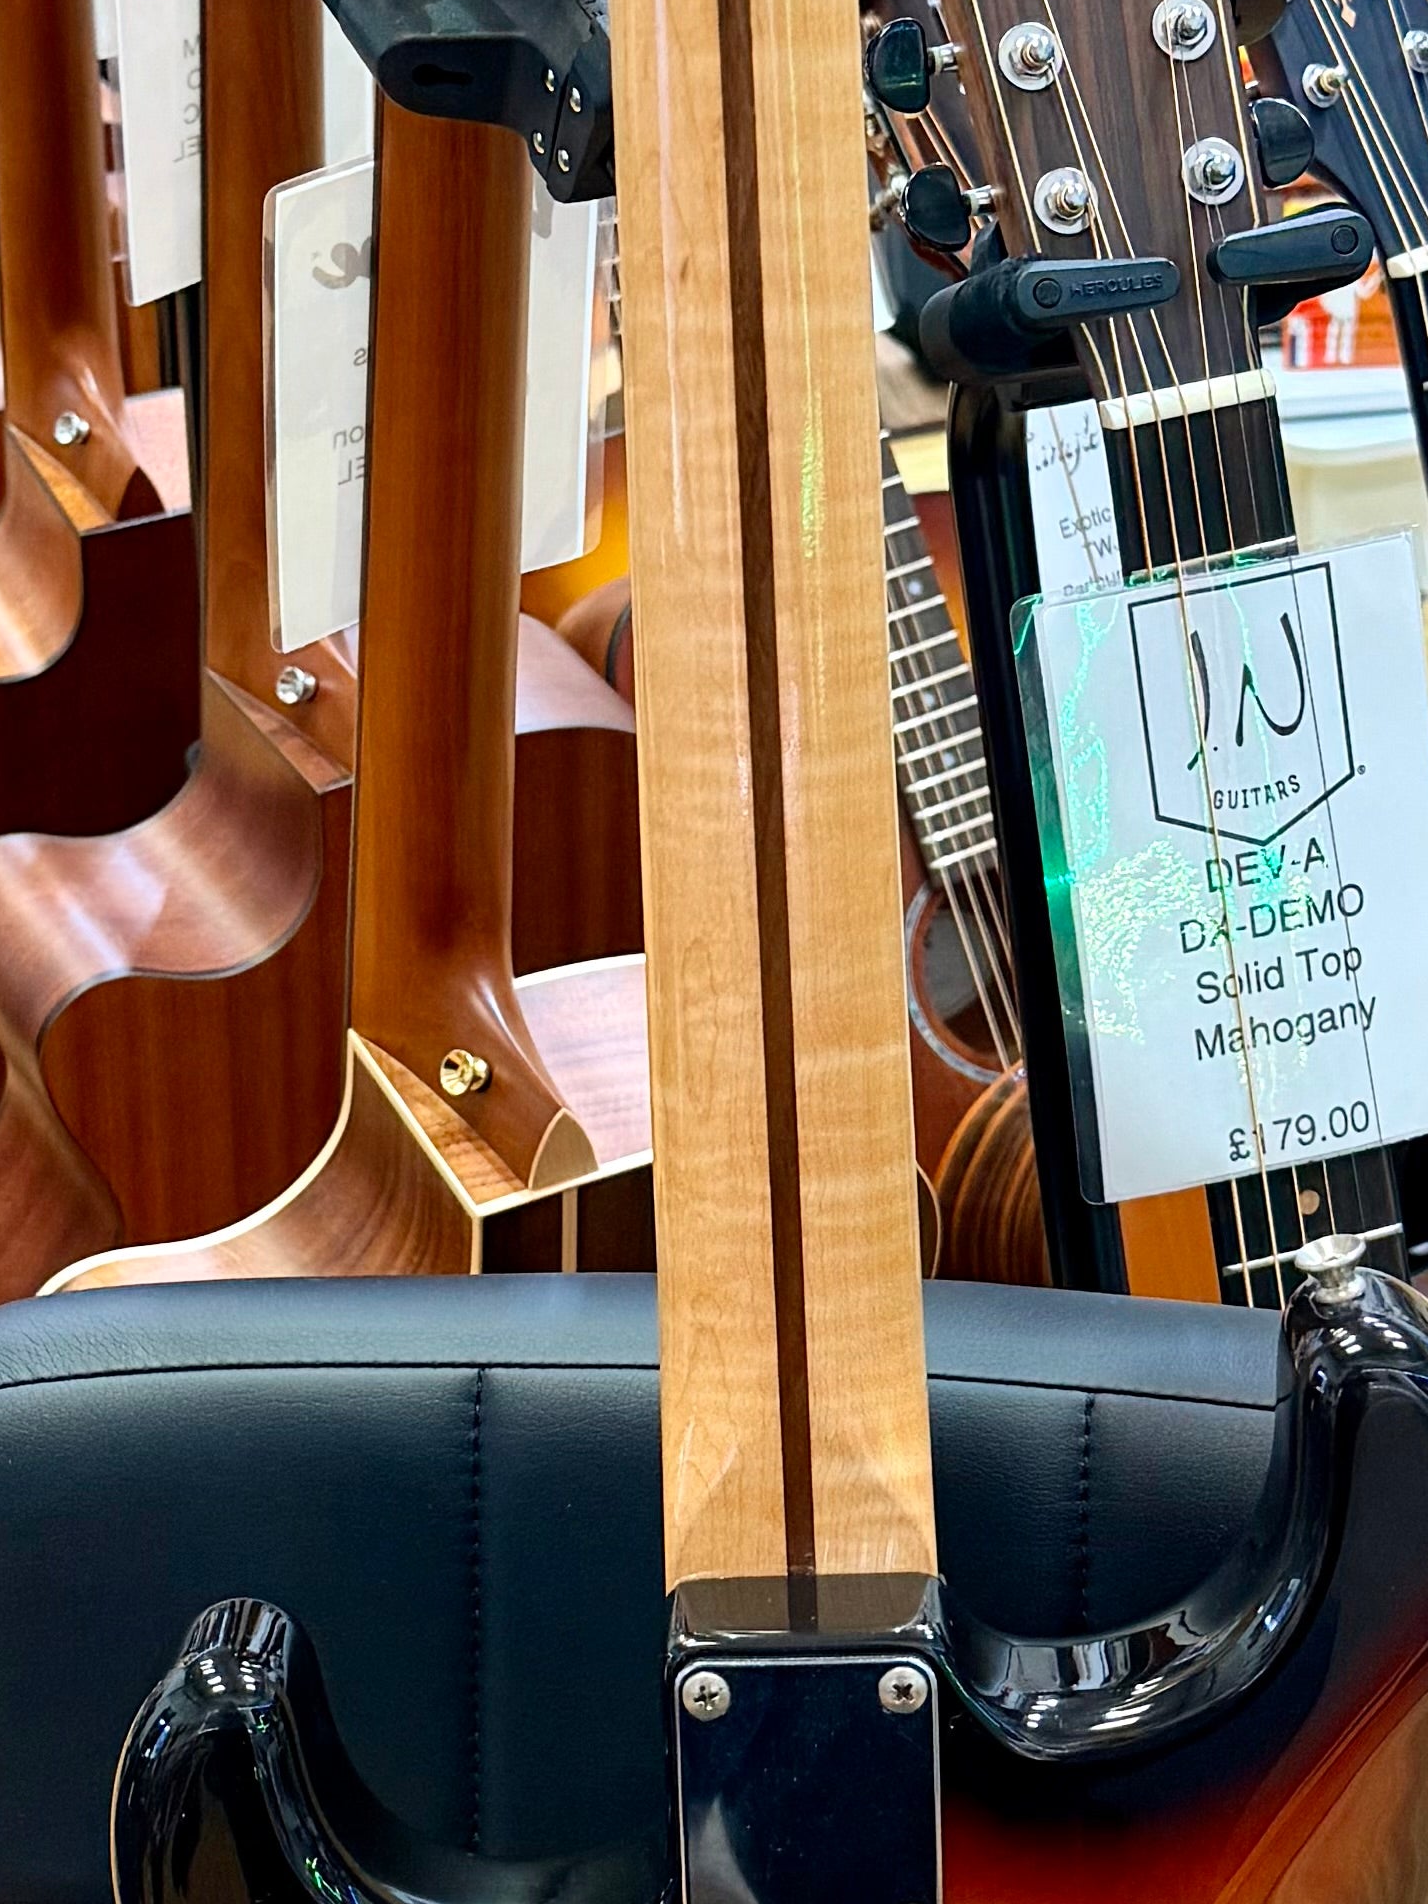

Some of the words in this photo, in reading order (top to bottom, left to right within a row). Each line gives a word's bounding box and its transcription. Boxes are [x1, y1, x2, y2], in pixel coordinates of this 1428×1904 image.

[1069, 273, 1163, 298] HERCULES
[1059, 506, 1112, 539] Exotic
[1213, 774, 1301, 810] GUITARS
[1205, 837, 1326, 893] DEV-A
[1197, 956, 1284, 1004] Solid
[1295, 946, 1362, 982] Top
[1194, 996, 1376, 1061] Mahogany
[1228, 1100, 1369, 1161] £179.00
